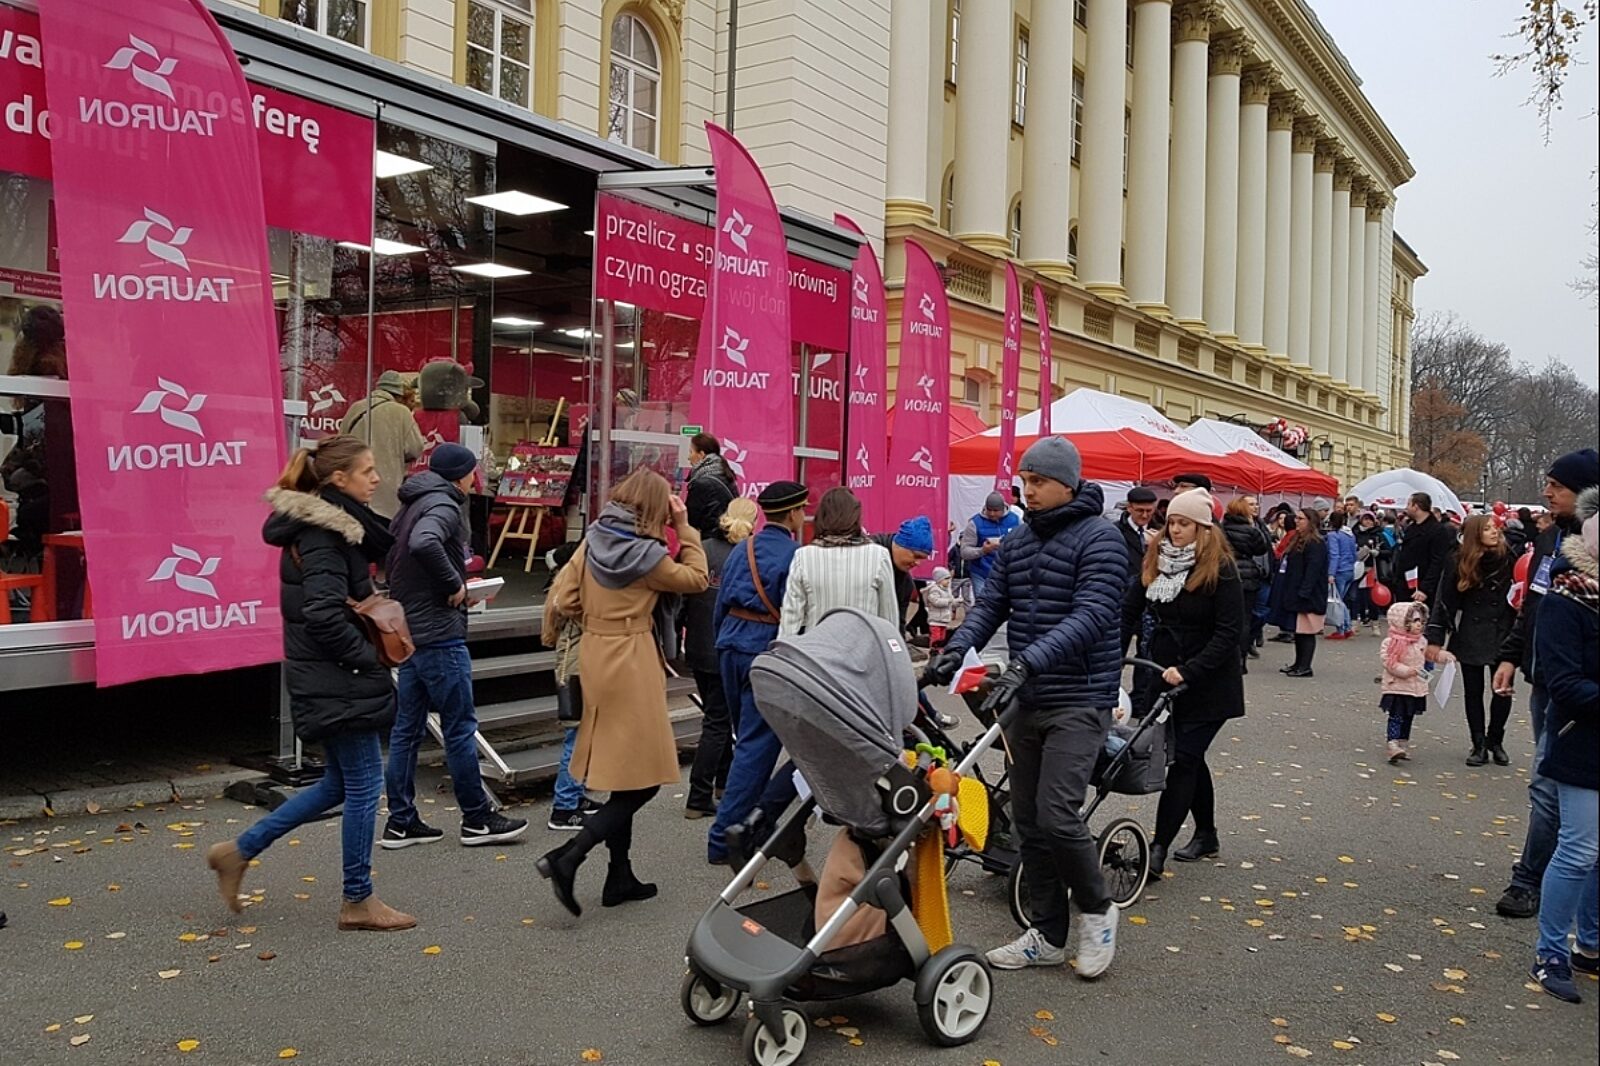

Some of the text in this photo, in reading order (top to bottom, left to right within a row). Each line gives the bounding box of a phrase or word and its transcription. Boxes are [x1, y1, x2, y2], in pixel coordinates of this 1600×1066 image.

[606, 213, 676, 252] przelicz
[605, 256, 654, 287] czym
[659, 269, 709, 299] ogrza
